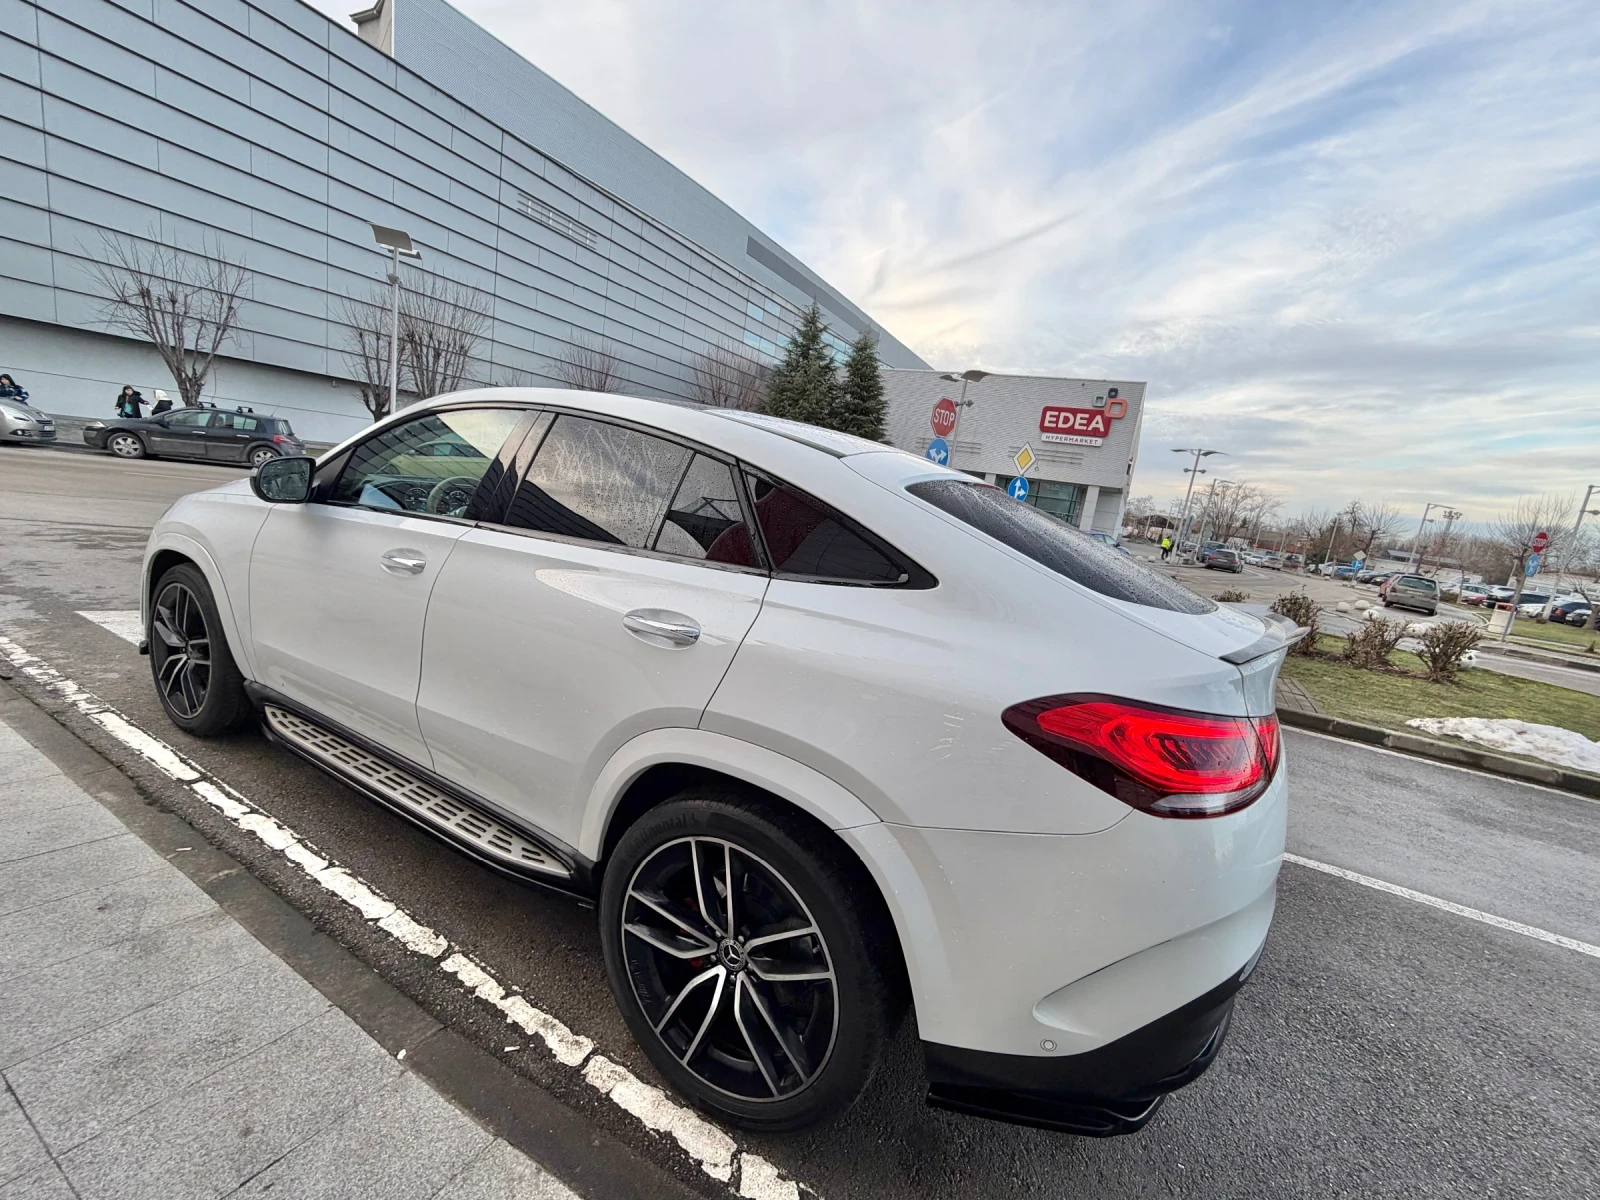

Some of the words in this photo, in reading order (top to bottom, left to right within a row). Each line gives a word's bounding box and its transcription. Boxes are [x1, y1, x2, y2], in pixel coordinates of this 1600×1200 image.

[934, 408, 955, 426] STOP
[1043, 410, 1105, 432] EDEA
[1045, 434, 1098, 445] HYPERMARKET
[1532, 538, 1547, 547] STOP
